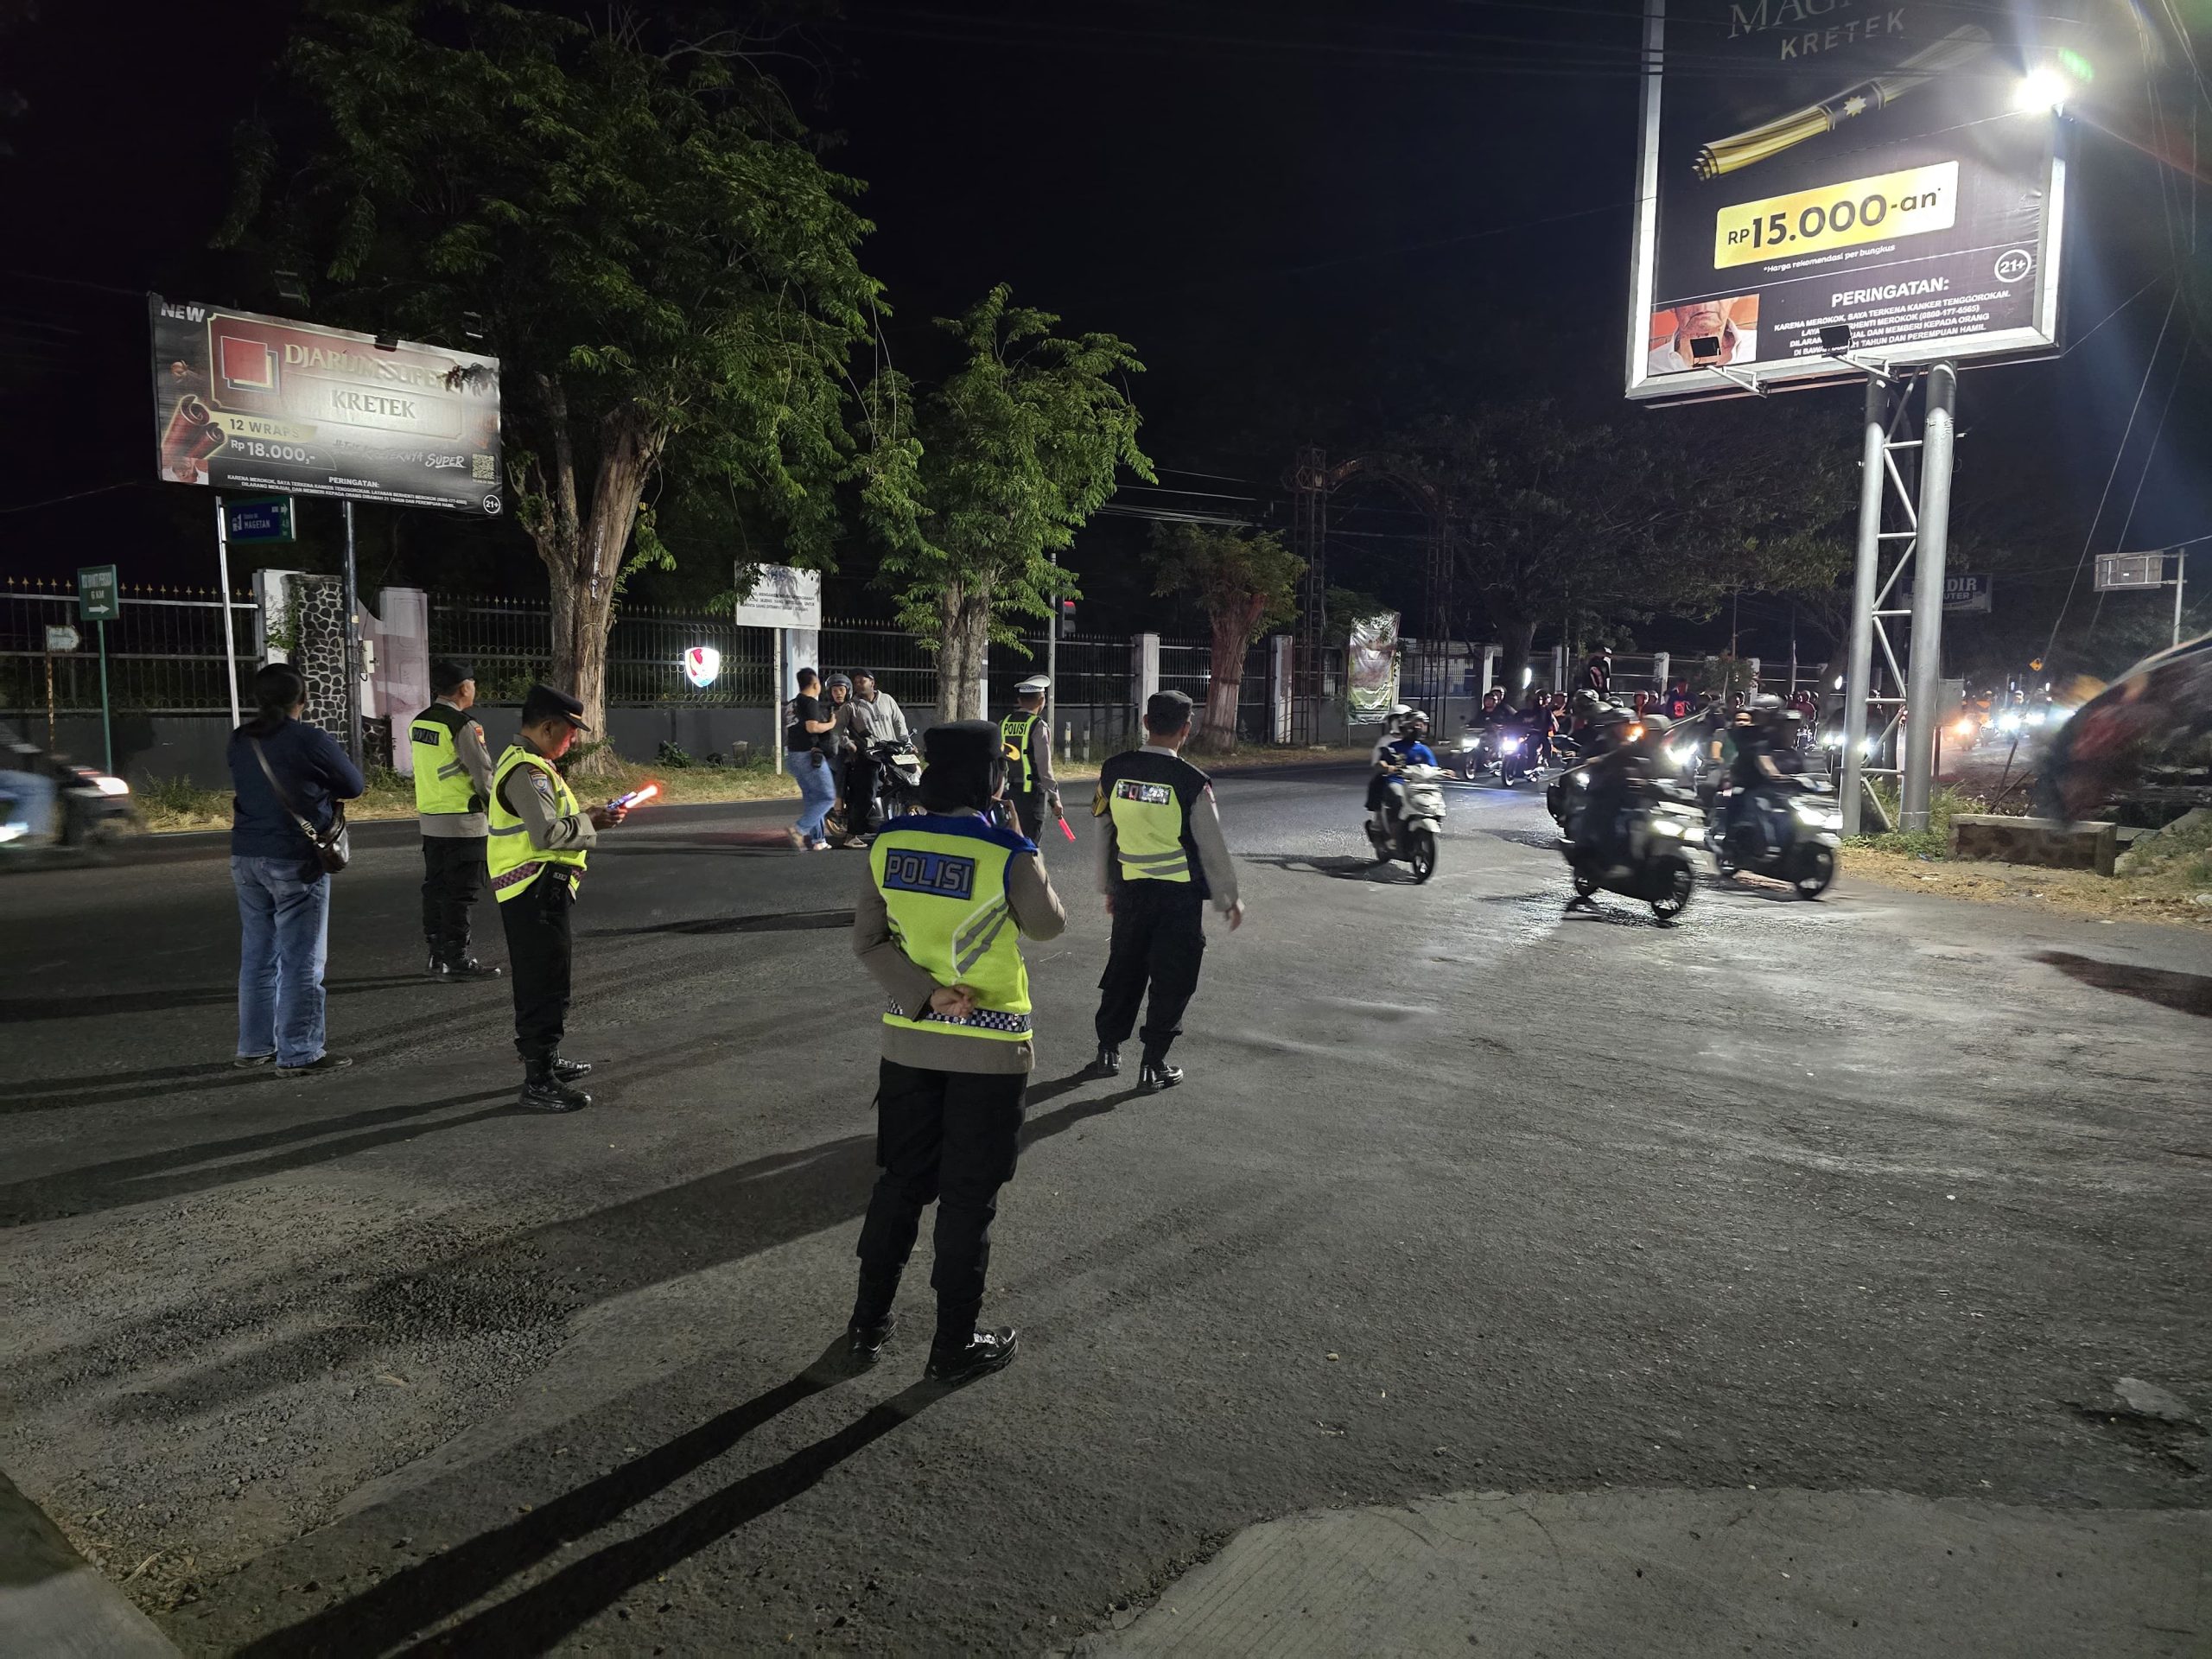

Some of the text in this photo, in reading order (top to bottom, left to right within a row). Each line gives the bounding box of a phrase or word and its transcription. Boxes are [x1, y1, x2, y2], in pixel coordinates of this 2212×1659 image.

[1781, 8, 1904, 60] KRETEK
[1793, 253, 1844, 269] rekomendasi
[1845, 251, 1859, 261] per
[1860, 245, 1896, 257] bungkus
[1999, 259, 2026, 274] 21+
[1831, 277, 1949, 308] PERINGATAN:
[161, 302, 206, 323] NEW
[1774, 290, 2012, 332] KARENA MEROKOK, SAYA TERKENA KANKER TENGGOROKAN.
[1877, 314, 1918, 327] MEROKOK
[1866, 328, 1884, 337] DAN
[1885, 321, 1923, 334] MEMBERI
[1923, 317, 1957, 329] KEPADA
[1958, 313, 1990, 324] ORANG
[1793, 348, 1802, 357] DI
[1861, 336, 1888, 347] TAHUN
[1888, 334, 1907, 343] DAN
[1907, 327, 1959, 341] PEREMPUAN
[1959, 323, 1987, 334] HAMIL
[284, 343, 448, 390] DJARUM SUPE
[331, 389, 416, 419] KRETEK
[230, 418, 300, 438] 12 WRAPS
[425, 453, 466, 468] SUPER
[291, 480, 315, 489] TERKENA
[372, 488, 392, 497] LAYANAN
[328, 476, 380, 489] PERINGATAN:
[486, 499, 499, 508] 21+
[244, 518, 270, 530] MAGETAN
[413, 728, 438, 745] POLISI
[1004, 722, 1027, 735] POLISI
[886, 855, 970, 892] POLISI
